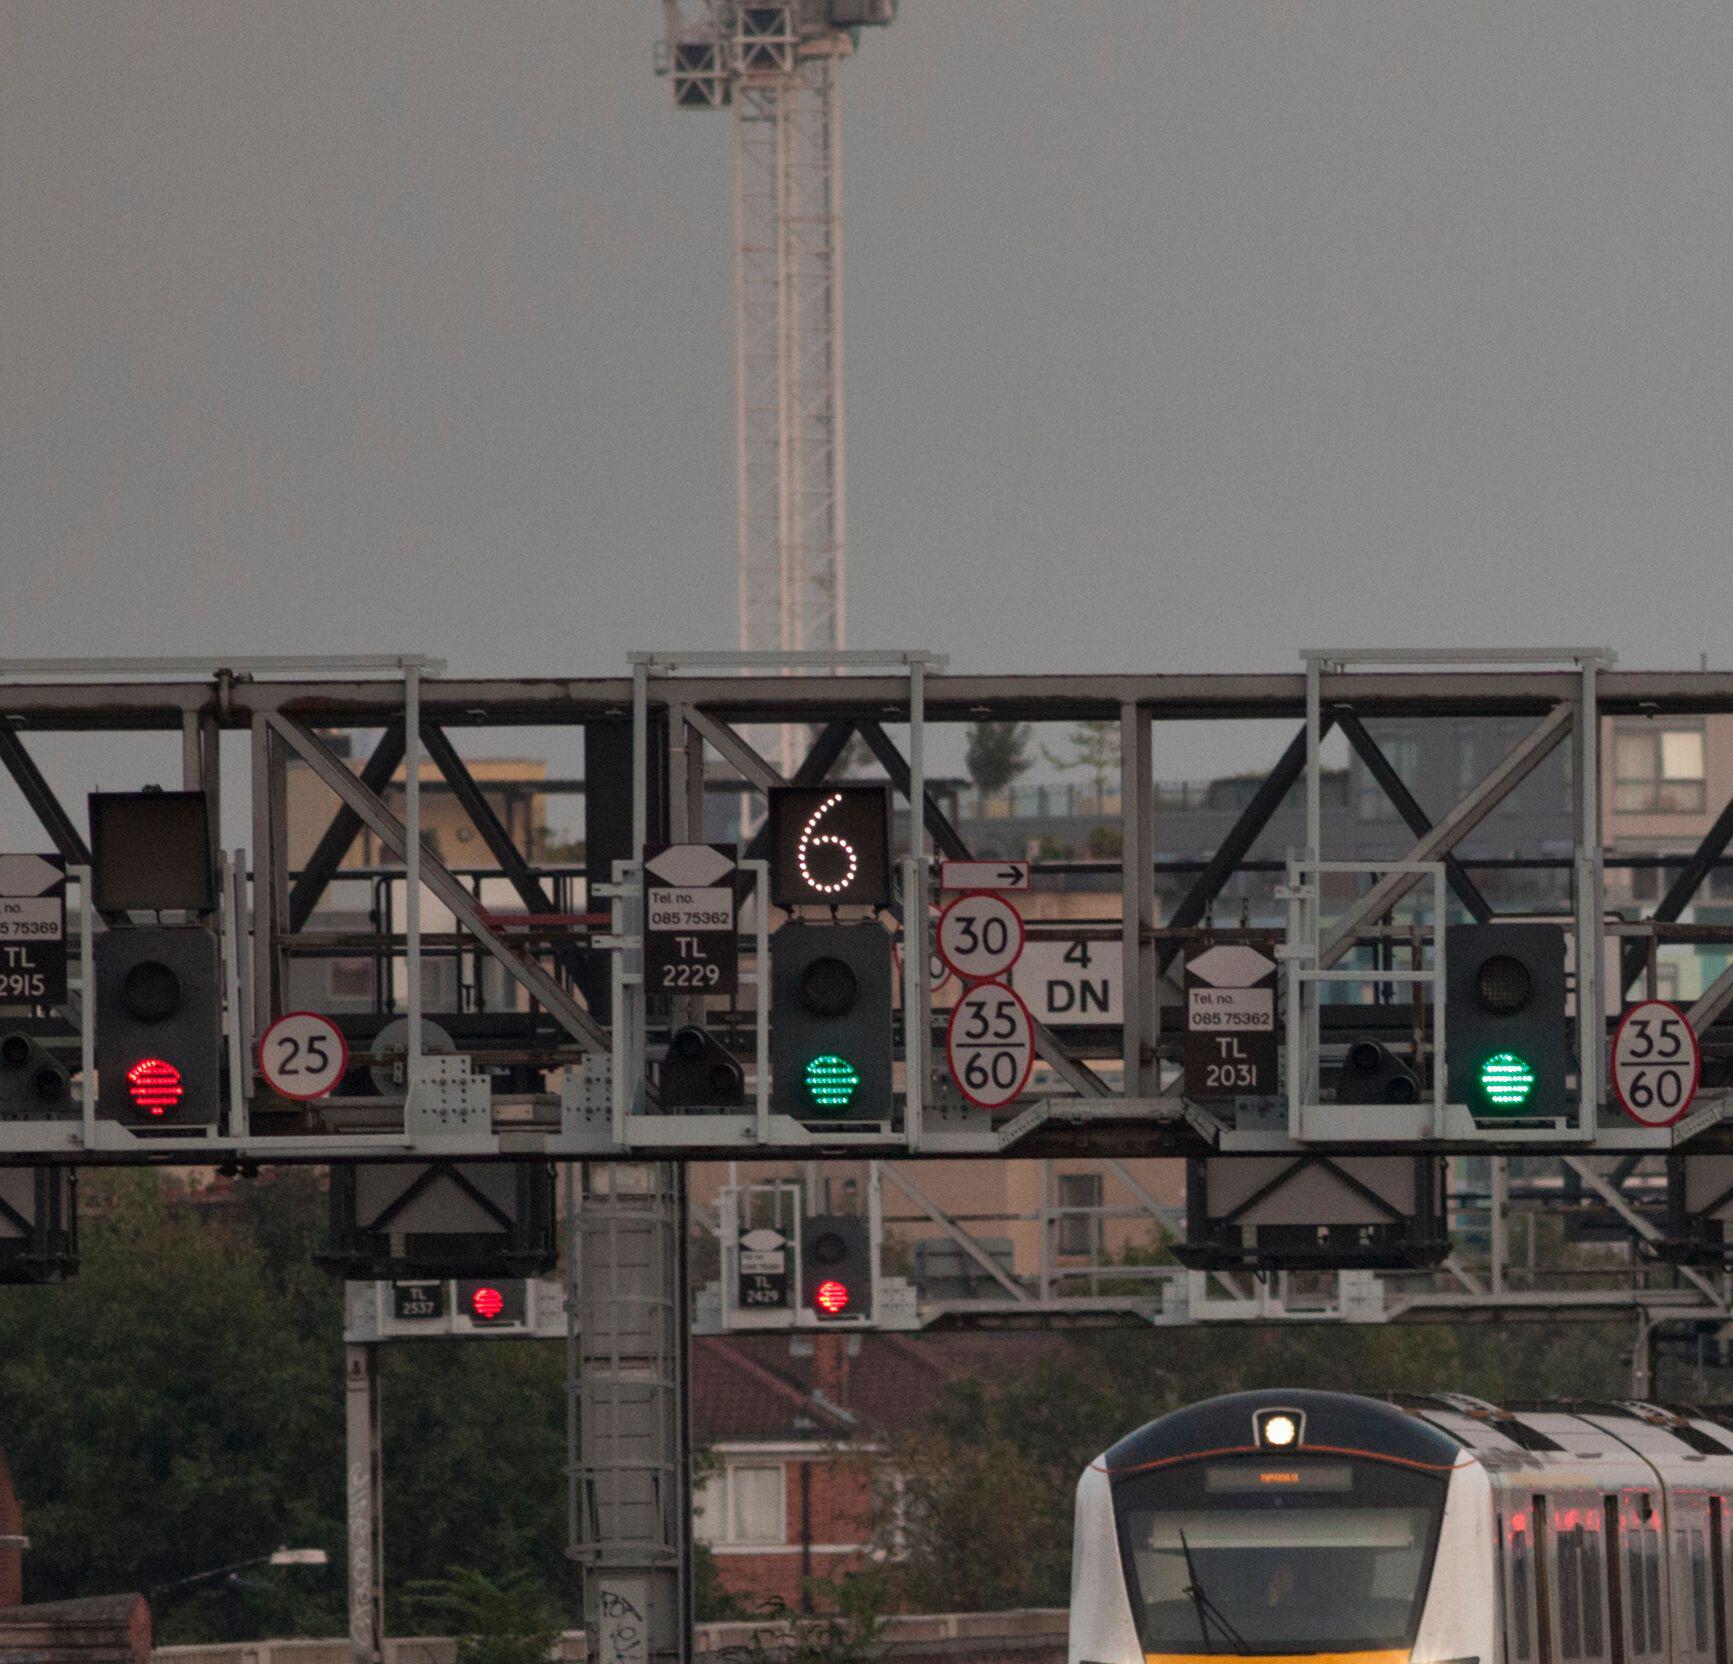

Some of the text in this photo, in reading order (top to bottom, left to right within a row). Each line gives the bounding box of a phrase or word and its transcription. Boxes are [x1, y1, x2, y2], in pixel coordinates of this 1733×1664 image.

[798, 793, 858, 893] 6
[652, 893, 694, 904] Tel. no.
[12, 921, 58, 934] 75369
[652, 912, 729, 924] 085 75362
[675, 937, 707, 958] TL
[954, 917, 1008, 955] 30
[3, 946, 36, 968] TL
[1064, 938, 1091, 969] 4
[0, 974, 46, 997] 2915
[662, 964, 720, 987] 2229
[1047, 980, 1109, 1012] DN
[1193, 993, 1235, 1004] Tel. no.
[965, 1001, 1017, 1039] 35
[1193, 1013, 1270, 1024] 085 75362
[1215, 1037, 1247, 1058] TL
[1630, 1019, 1681, 1058] 35
[277, 1035, 329, 1076] 25
[964, 1052, 1017, 1089] 60
[1206, 1064, 1257, 1087] 2031
[1629, 1070, 1682, 1108] 60
[409, 1288, 426, 1300] TL
